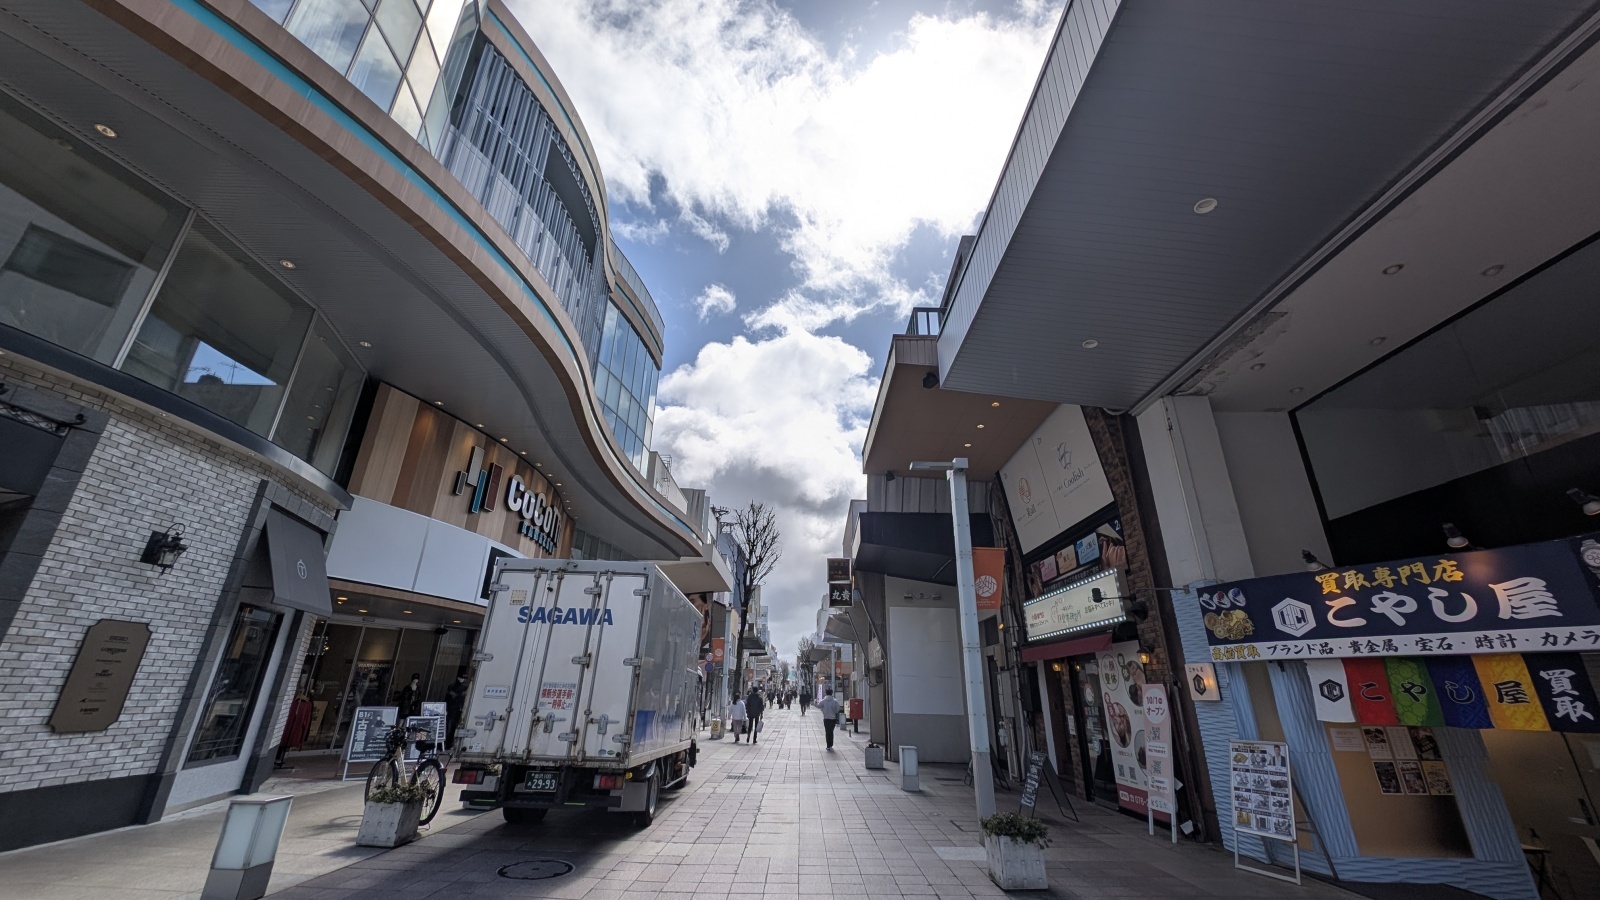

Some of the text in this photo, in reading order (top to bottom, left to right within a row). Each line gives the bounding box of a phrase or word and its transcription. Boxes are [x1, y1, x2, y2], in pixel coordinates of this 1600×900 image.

[1314, 558, 1465, 595] 買取専門店
[517, 605, 614, 625] SAGAWA
[1325, 577, 1564, 628] こやし屋
[1212, 645, 1260, 660] 高価買取
[1146, 707, 1165, 716] オープン
[1539, 668, 1595, 723] 買取
[352, 719, 369, 752] 古着屋
